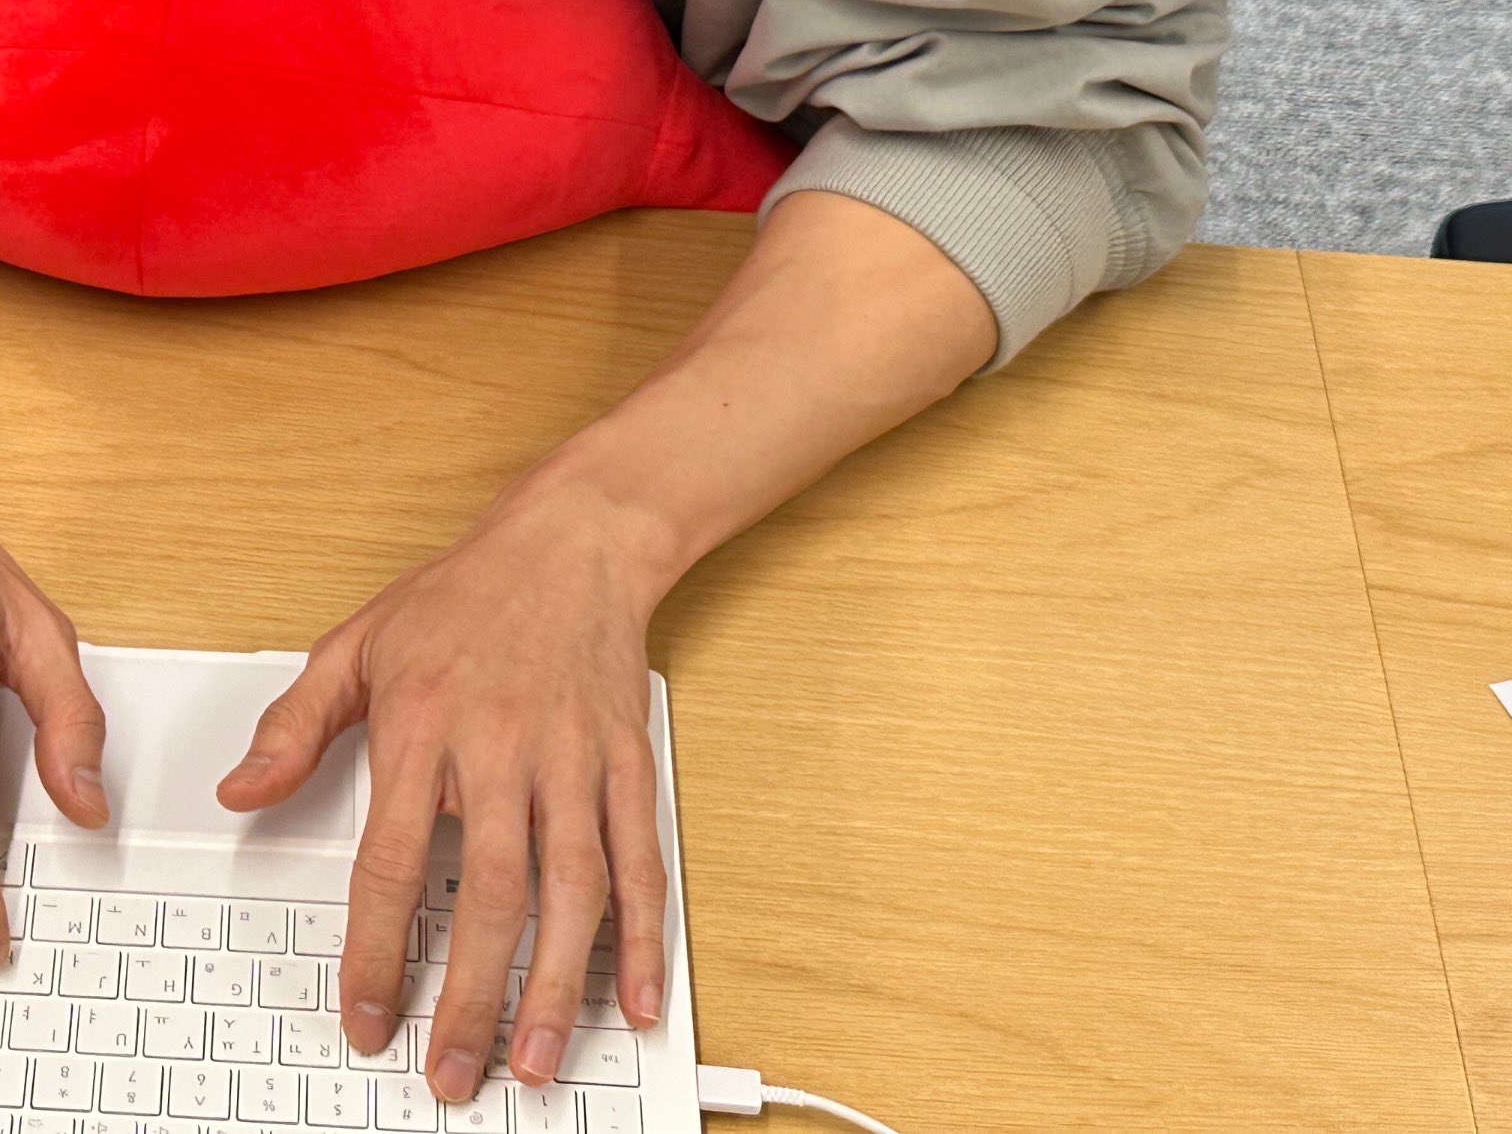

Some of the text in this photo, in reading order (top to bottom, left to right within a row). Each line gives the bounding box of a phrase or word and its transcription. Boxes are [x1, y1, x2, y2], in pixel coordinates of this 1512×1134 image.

[68, 921, 82, 933] M
[134, 924, 146, 936] N
[201, 928, 211, 940] B
[267, 932, 277, 944] V
[333, 935, 342, 947] C
[33, 973, 43, 985] K
[99, 977, 107, 989] J
[164, 980, 175, 992] H
[231, 983, 242, 996] G
[299, 988, 308, 1000] F
[502, 1000, 511, 1012] A
[116, 1034, 127, 1046] U
[184, 1037, 194, 1049] Y
[252, 1041, 261, 1054] T
[320, 1045, 330, 1057] R
[388, 1049, 397, 1061] E
[601, 1054, 619, 1064] Tab
[61, 1066, 70, 1078] 8
[128, 1071, 136, 1082] 7
[197, 1074, 206, 1086] 6
[266, 1078, 274, 1090] 5
[334, 1082, 343, 1094] 4
[403, 1086, 411, 1098] 3
[263, 1100, 275, 1112] %
[470, 1112, 483, 1125] @
